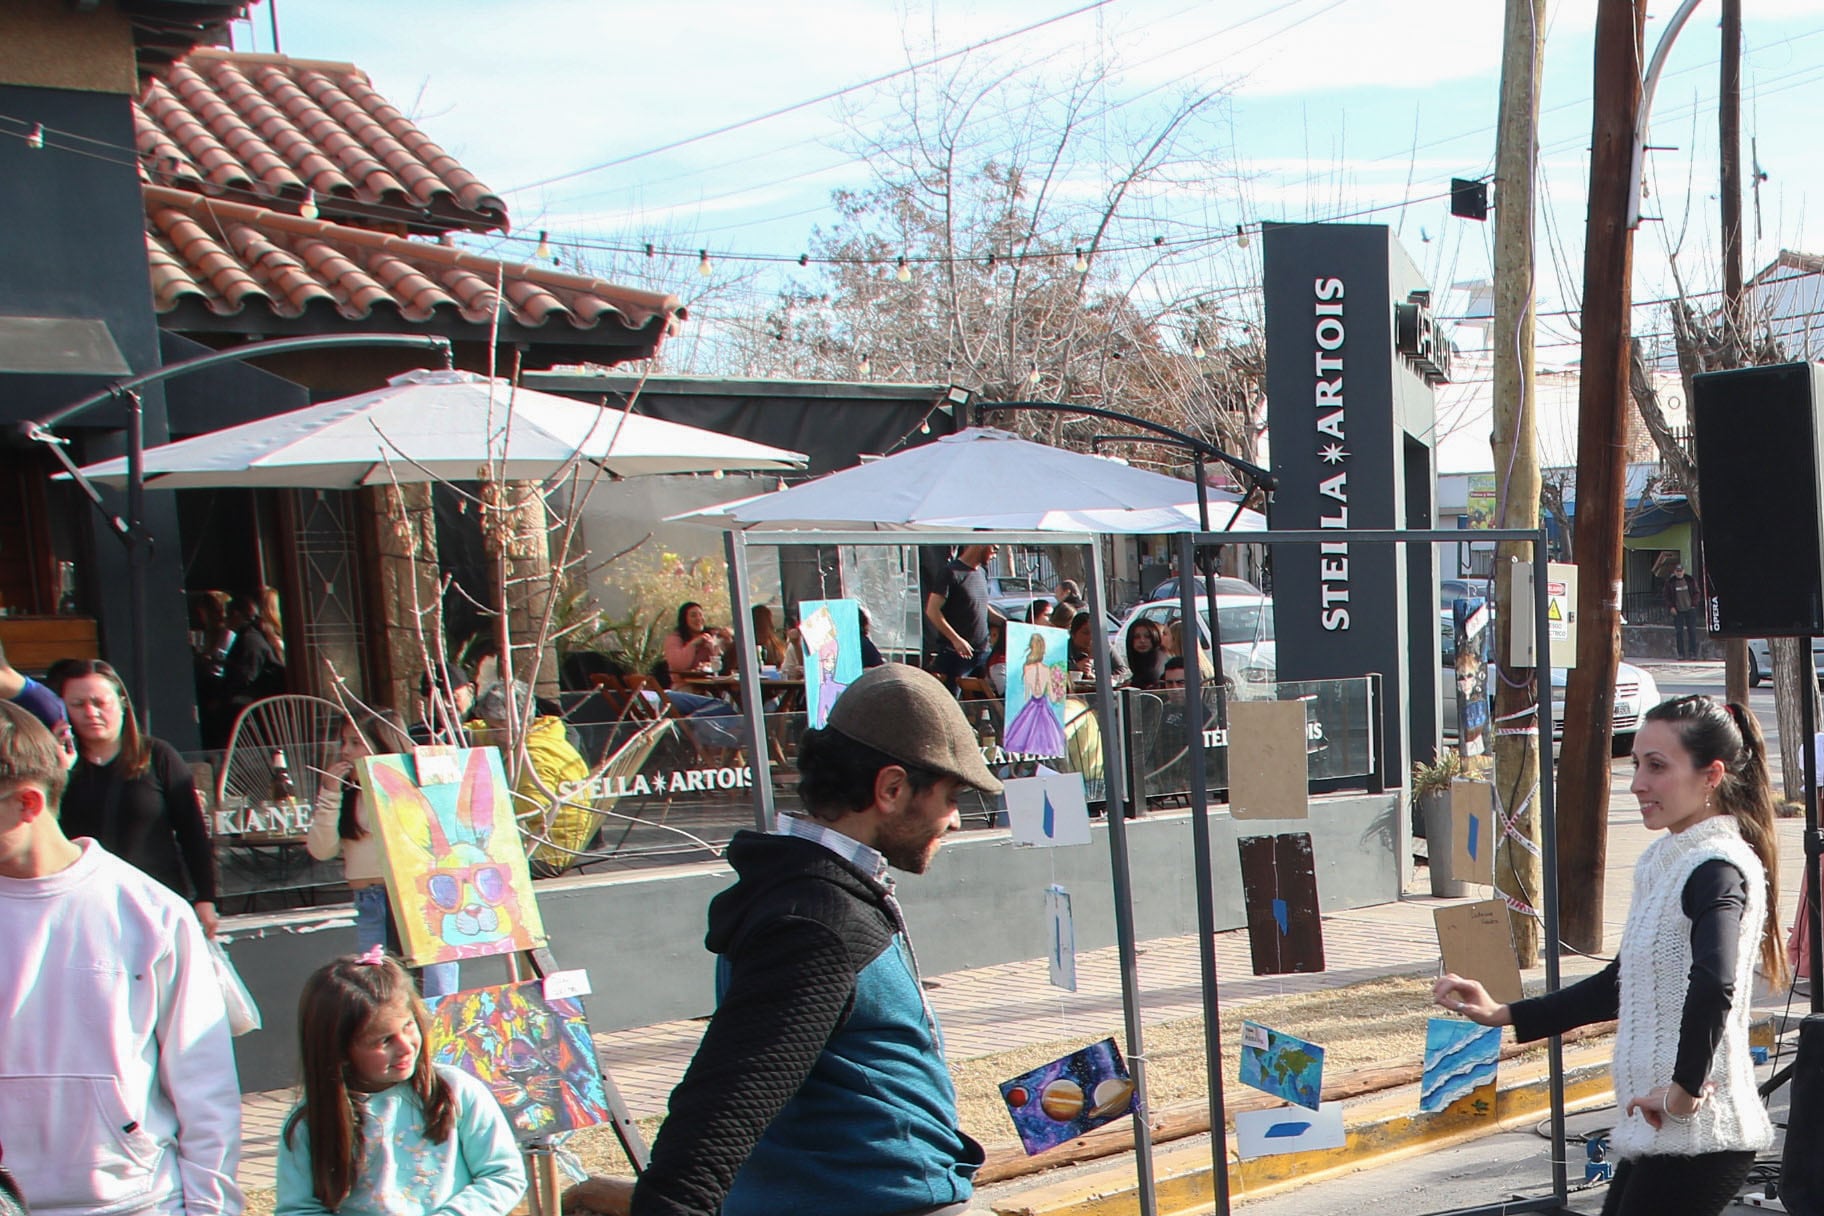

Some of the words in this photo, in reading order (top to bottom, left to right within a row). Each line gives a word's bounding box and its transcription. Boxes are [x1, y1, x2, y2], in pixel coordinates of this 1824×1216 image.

[1314, 276, 1346, 440] ARTOIS
[1711, 596, 1721, 632] OPERA
[558, 772, 652, 801] STELLA
